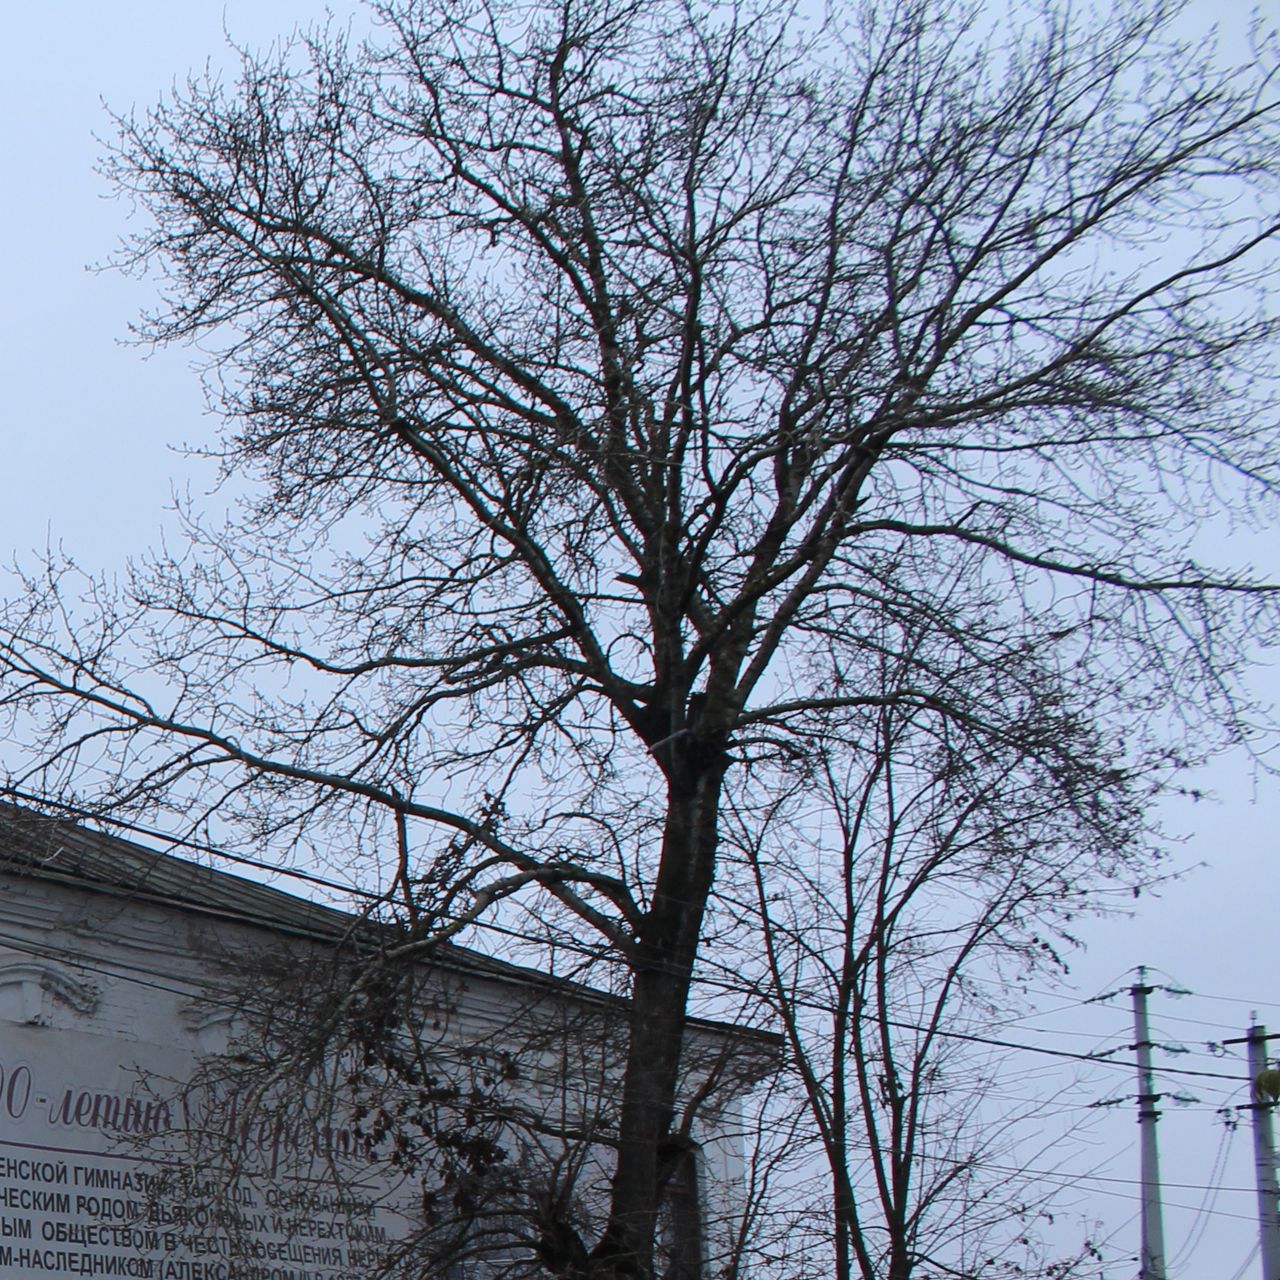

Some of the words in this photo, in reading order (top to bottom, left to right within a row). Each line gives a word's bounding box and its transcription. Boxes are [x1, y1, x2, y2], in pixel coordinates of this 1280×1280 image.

[76, 1195, 139, 1221] РОДОМ
[41, 1221, 159, 1252] ОБЩЕСТВОМ
[164, 1233, 176, 1251] В
